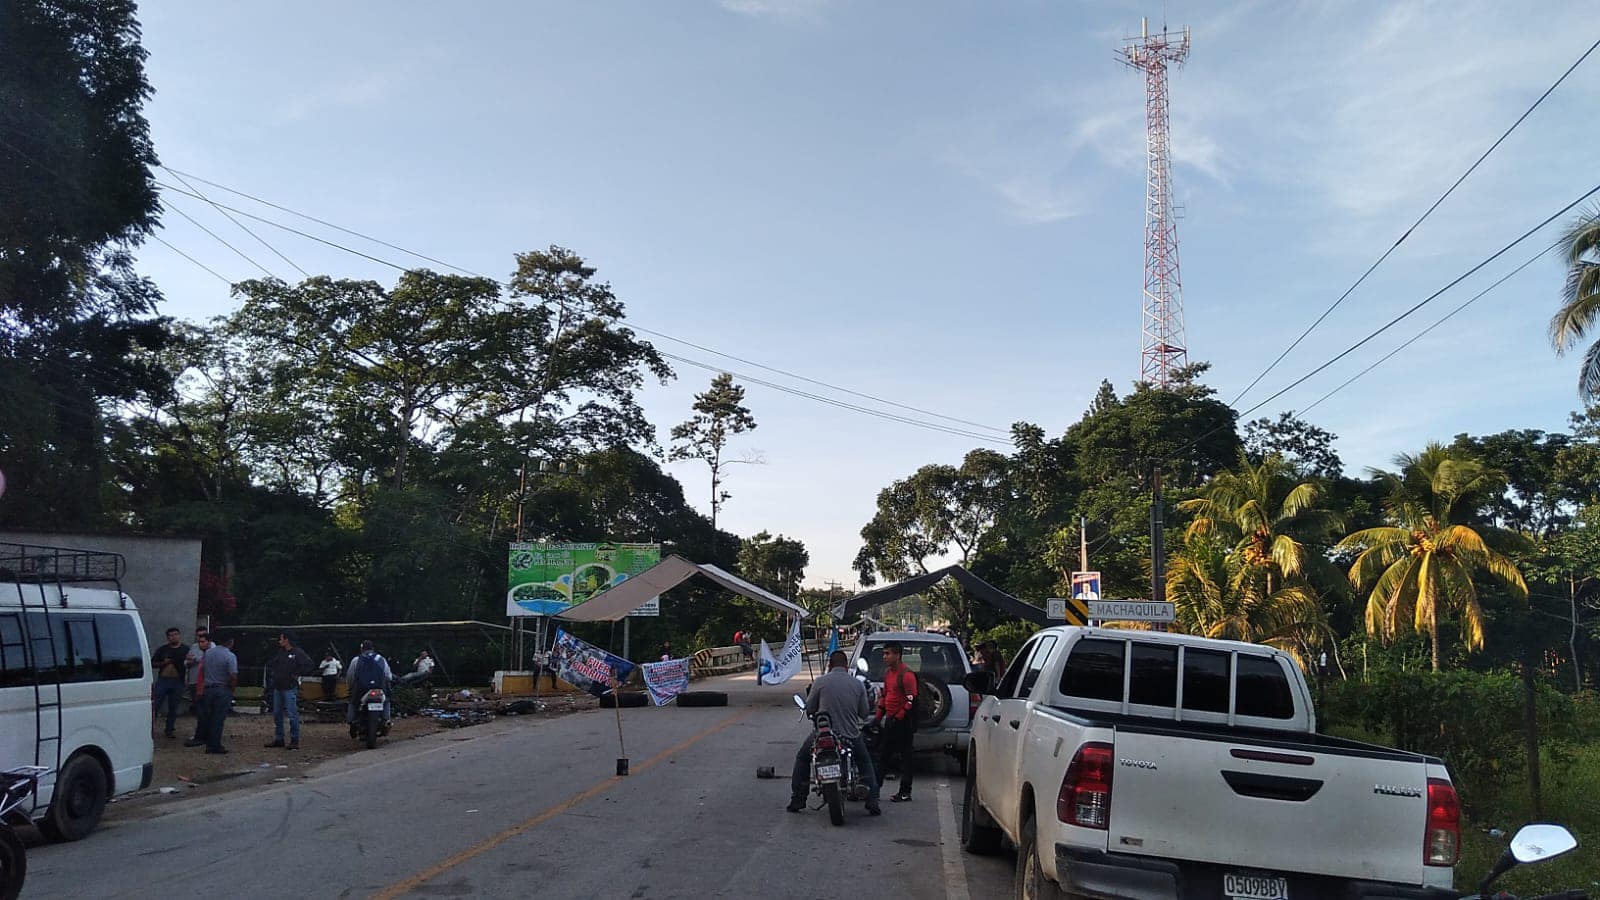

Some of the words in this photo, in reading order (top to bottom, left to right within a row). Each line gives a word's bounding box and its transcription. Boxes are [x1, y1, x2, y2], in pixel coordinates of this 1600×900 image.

[1097, 603, 1169, 617] MACHAQUILA
[1120, 758, 1157, 770] TOYOTA
[1374, 784, 1421, 798] HILUX
